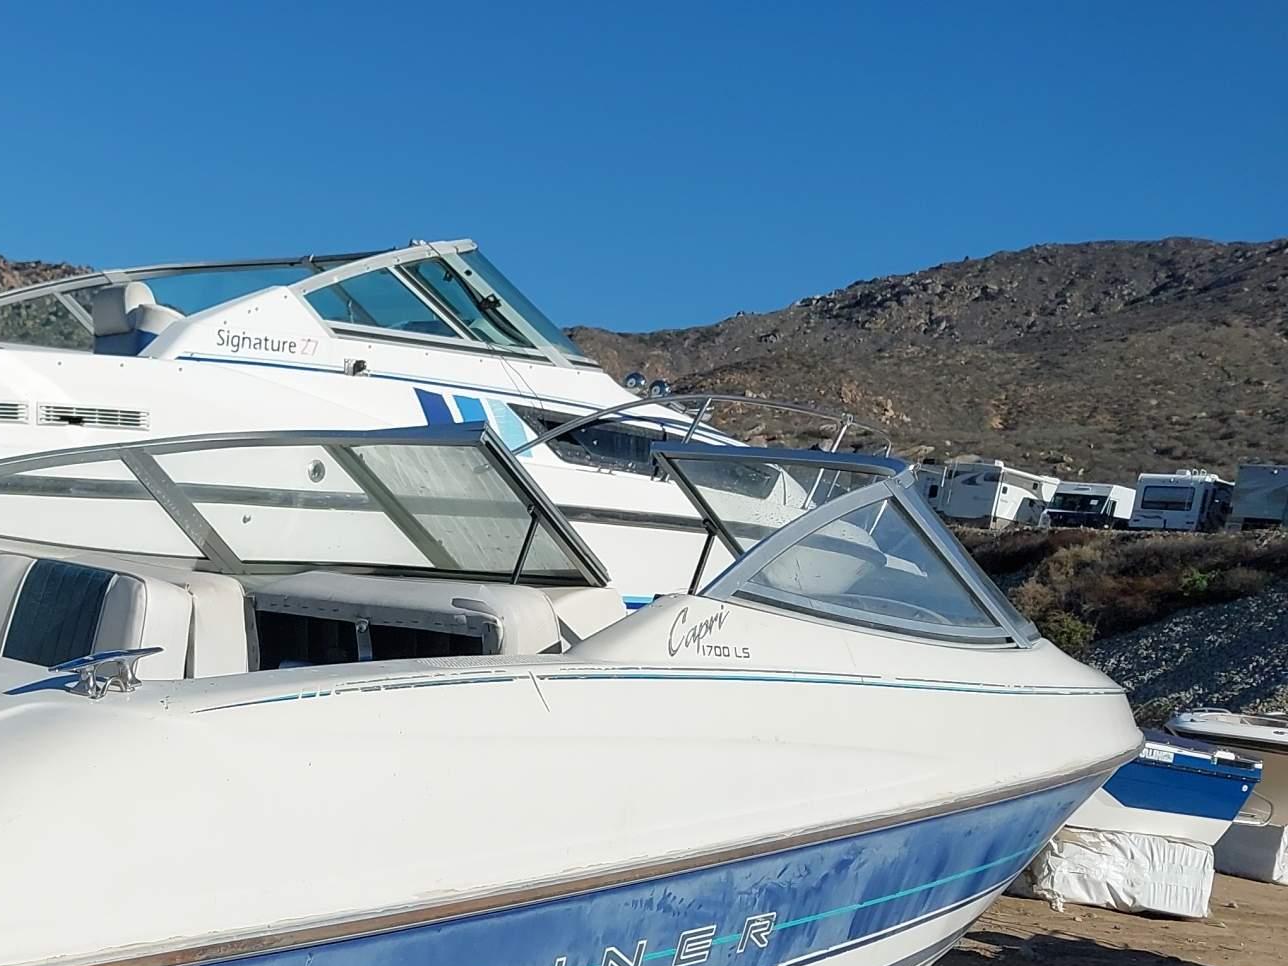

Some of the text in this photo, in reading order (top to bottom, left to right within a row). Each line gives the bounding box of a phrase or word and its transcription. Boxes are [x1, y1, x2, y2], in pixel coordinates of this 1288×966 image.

[216, 328, 297, 354] Signature
[668, 604, 730, 657] Capri
[702, 645, 750, 658] 1700 LS
